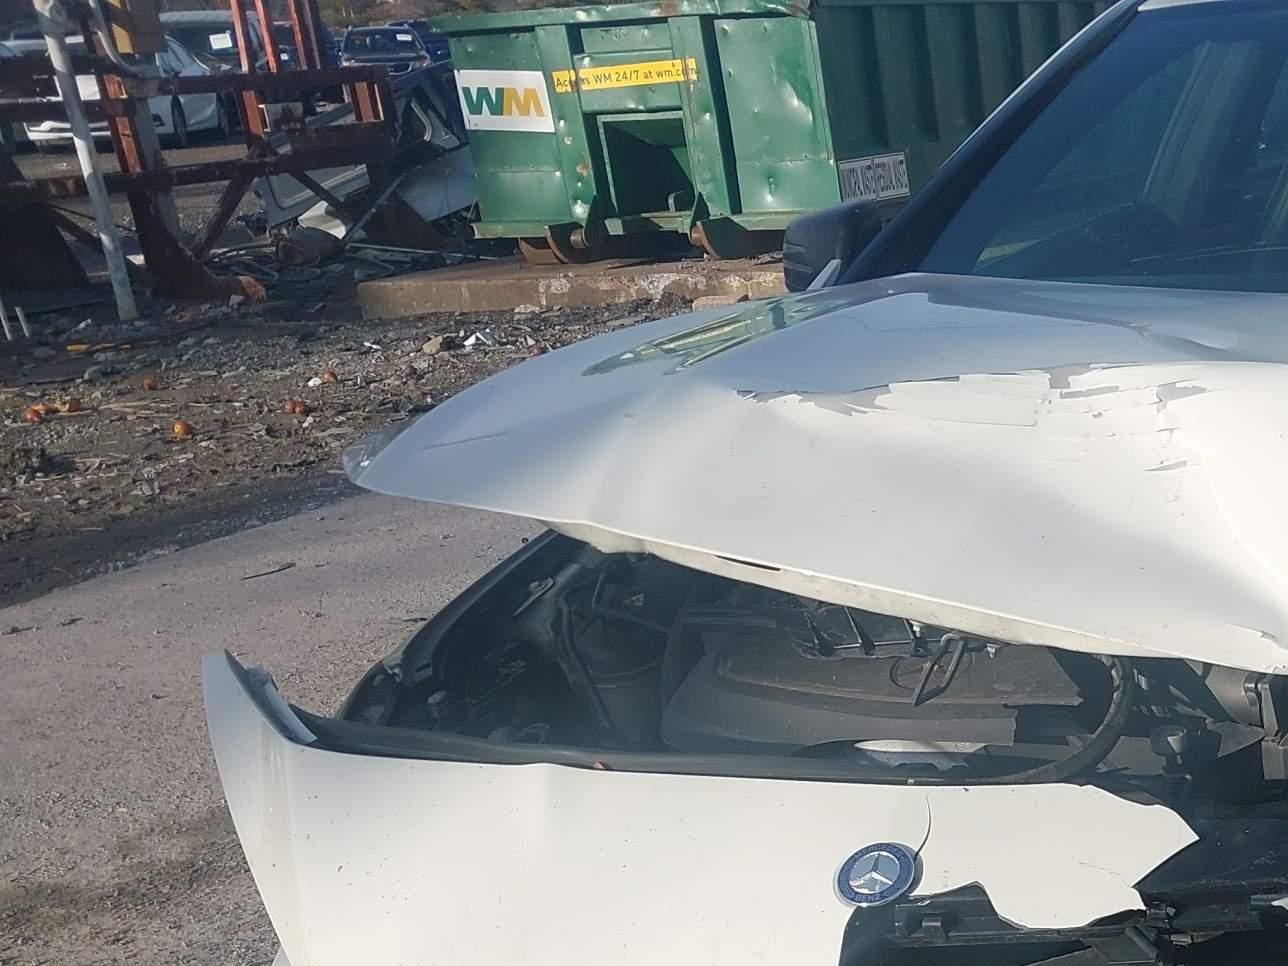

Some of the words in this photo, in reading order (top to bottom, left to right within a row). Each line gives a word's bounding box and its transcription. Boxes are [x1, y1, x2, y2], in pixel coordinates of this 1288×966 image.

[592, 73, 612, 85] WM
[615, 69, 640, 82] 24/7
[643, 69, 653, 79] at
[462, 86, 546, 117] WM
[855, 894, 882, 903] BENZ
